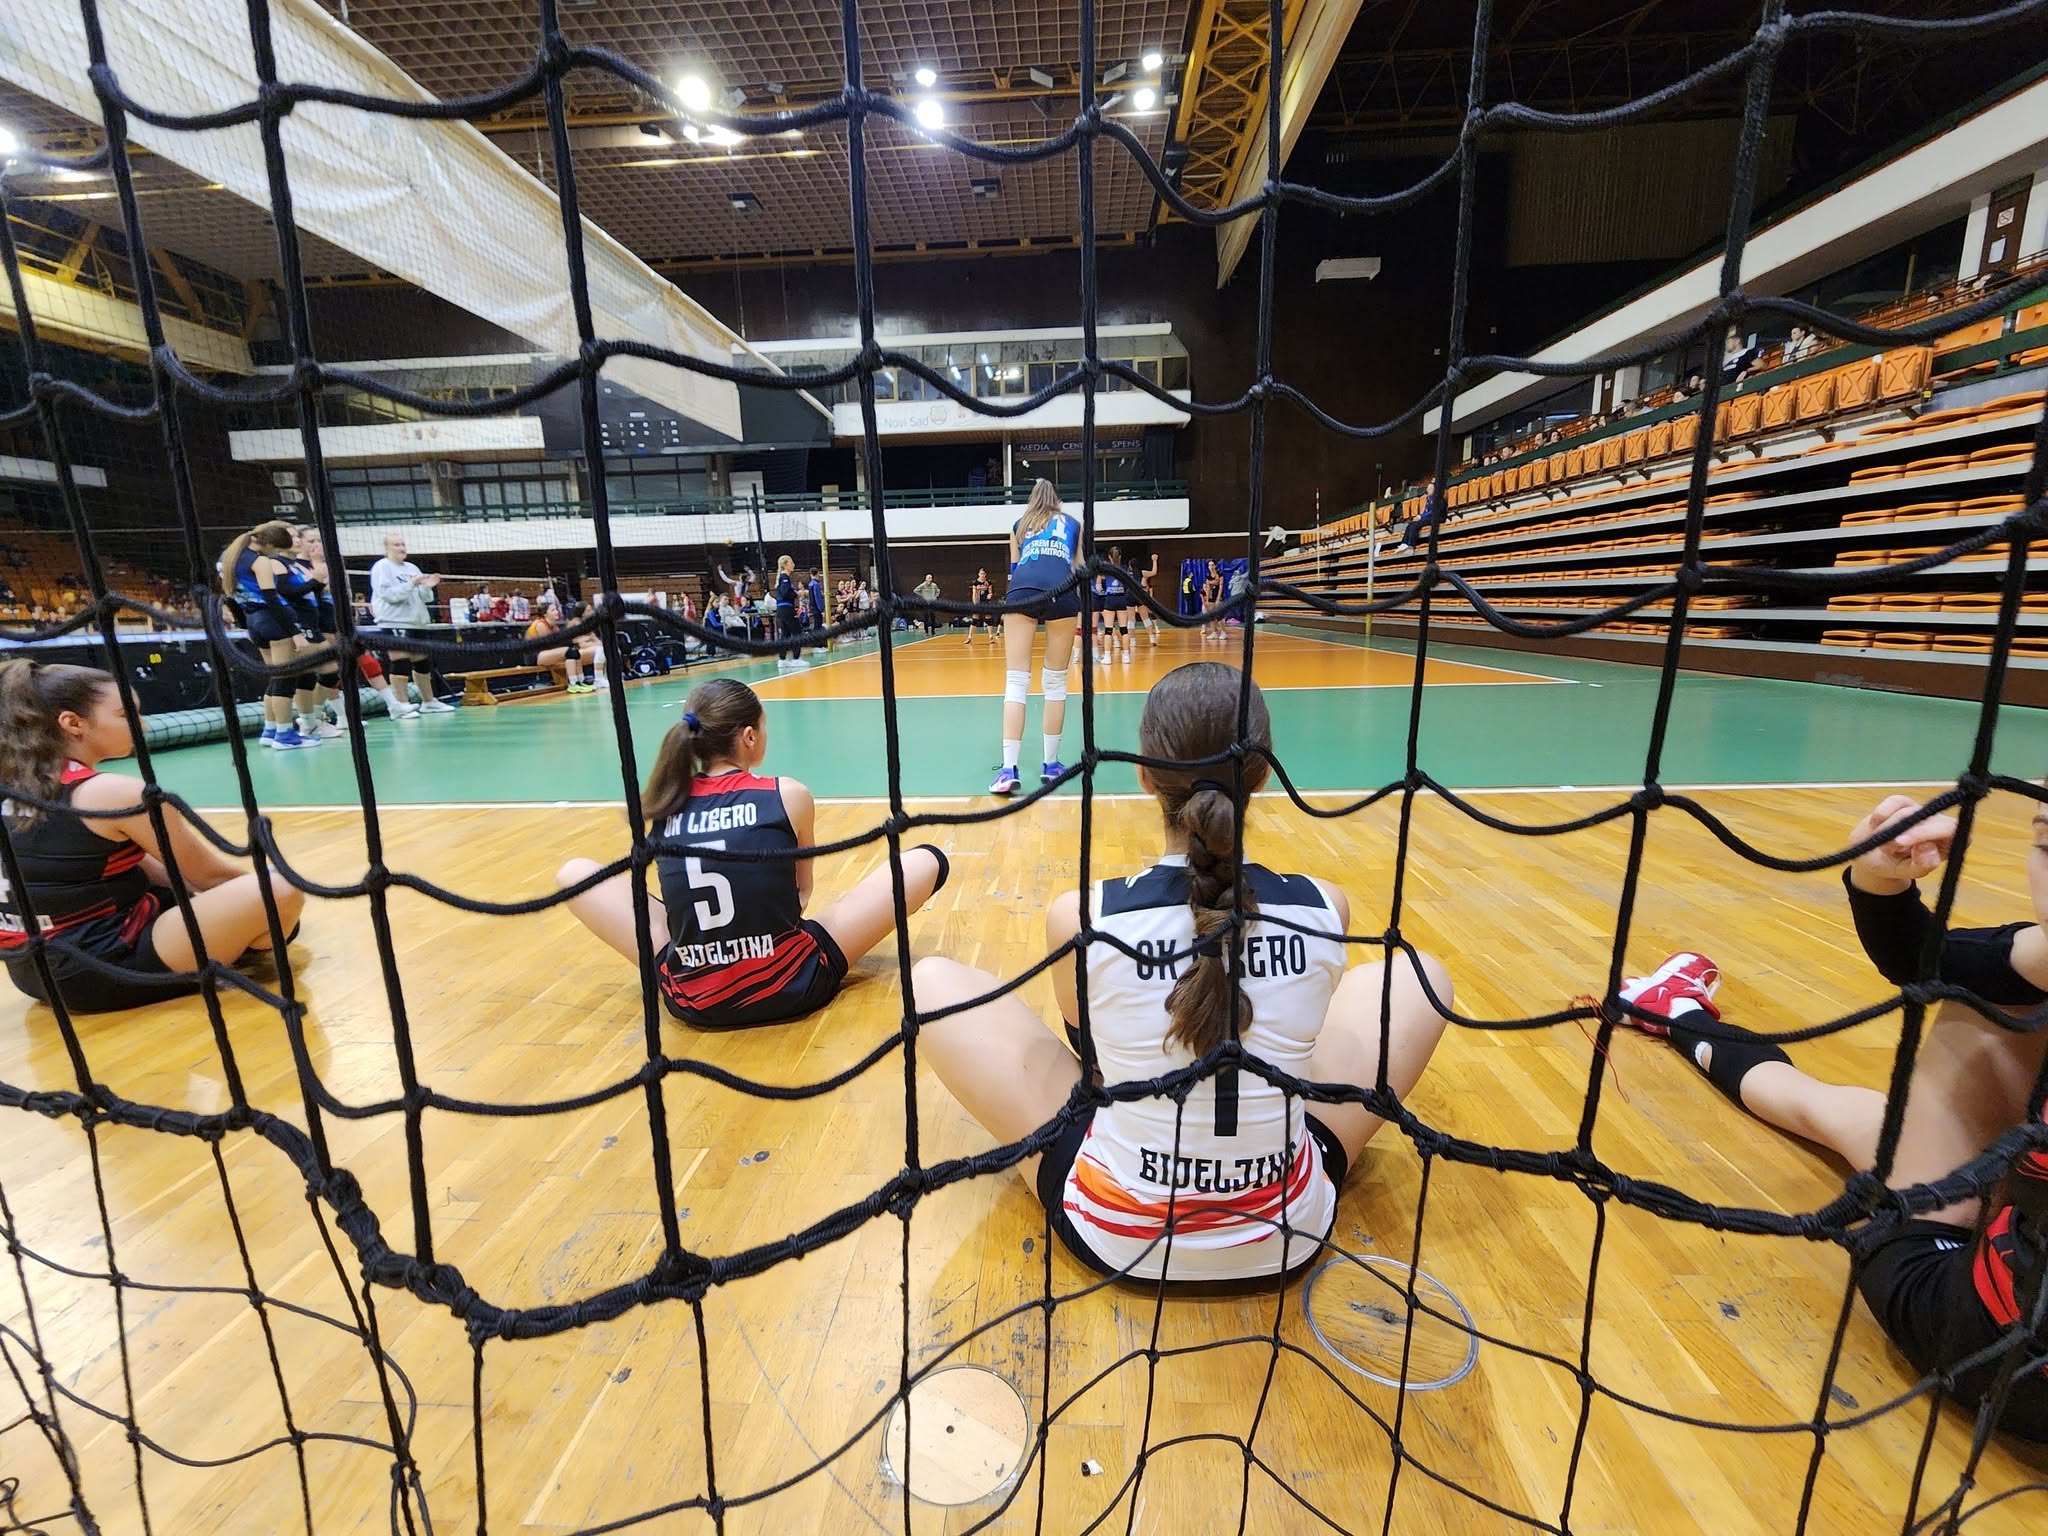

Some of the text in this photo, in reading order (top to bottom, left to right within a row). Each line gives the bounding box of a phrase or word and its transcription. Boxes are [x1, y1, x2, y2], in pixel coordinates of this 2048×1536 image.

[910, 416, 929, 427] Sad
[1020, 442, 1050, 452] MEDIA
[1111, 440, 1141, 449] SPENS
[687, 802, 757, 834] LIBERO
[685, 839, 735, 931] 5
[675, 934, 775, 968] BIJELJINA
[1136, 939, 1178, 980] OK
